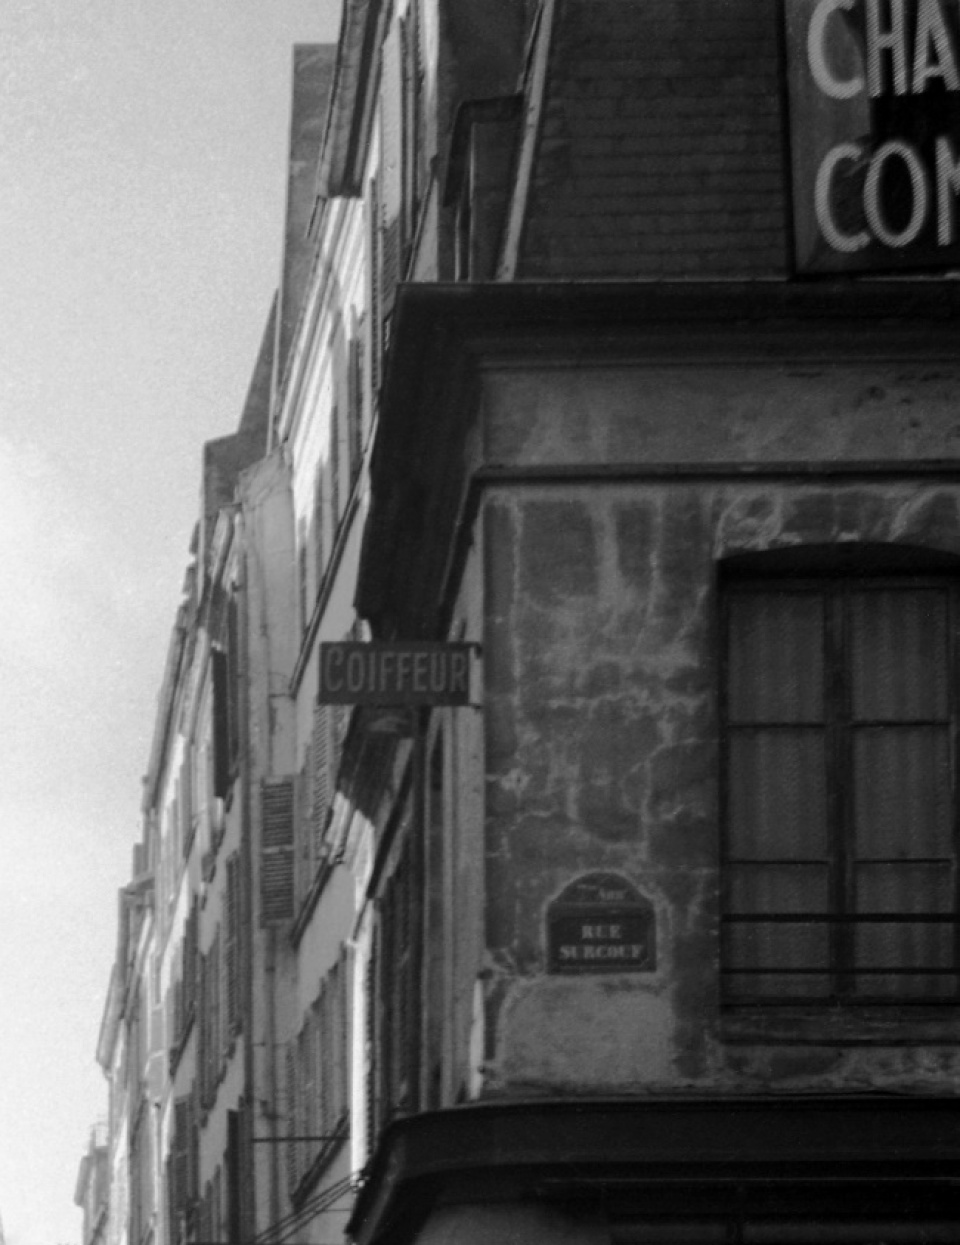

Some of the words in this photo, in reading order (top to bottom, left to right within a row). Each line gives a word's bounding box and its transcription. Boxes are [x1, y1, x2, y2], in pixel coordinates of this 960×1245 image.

[807, 0, 960, 99] CHA
[324, 645, 467, 693] COIFFEUR
[581, 925, 622, 939] RUE
[559, 944, 644, 960] SURCOUF
